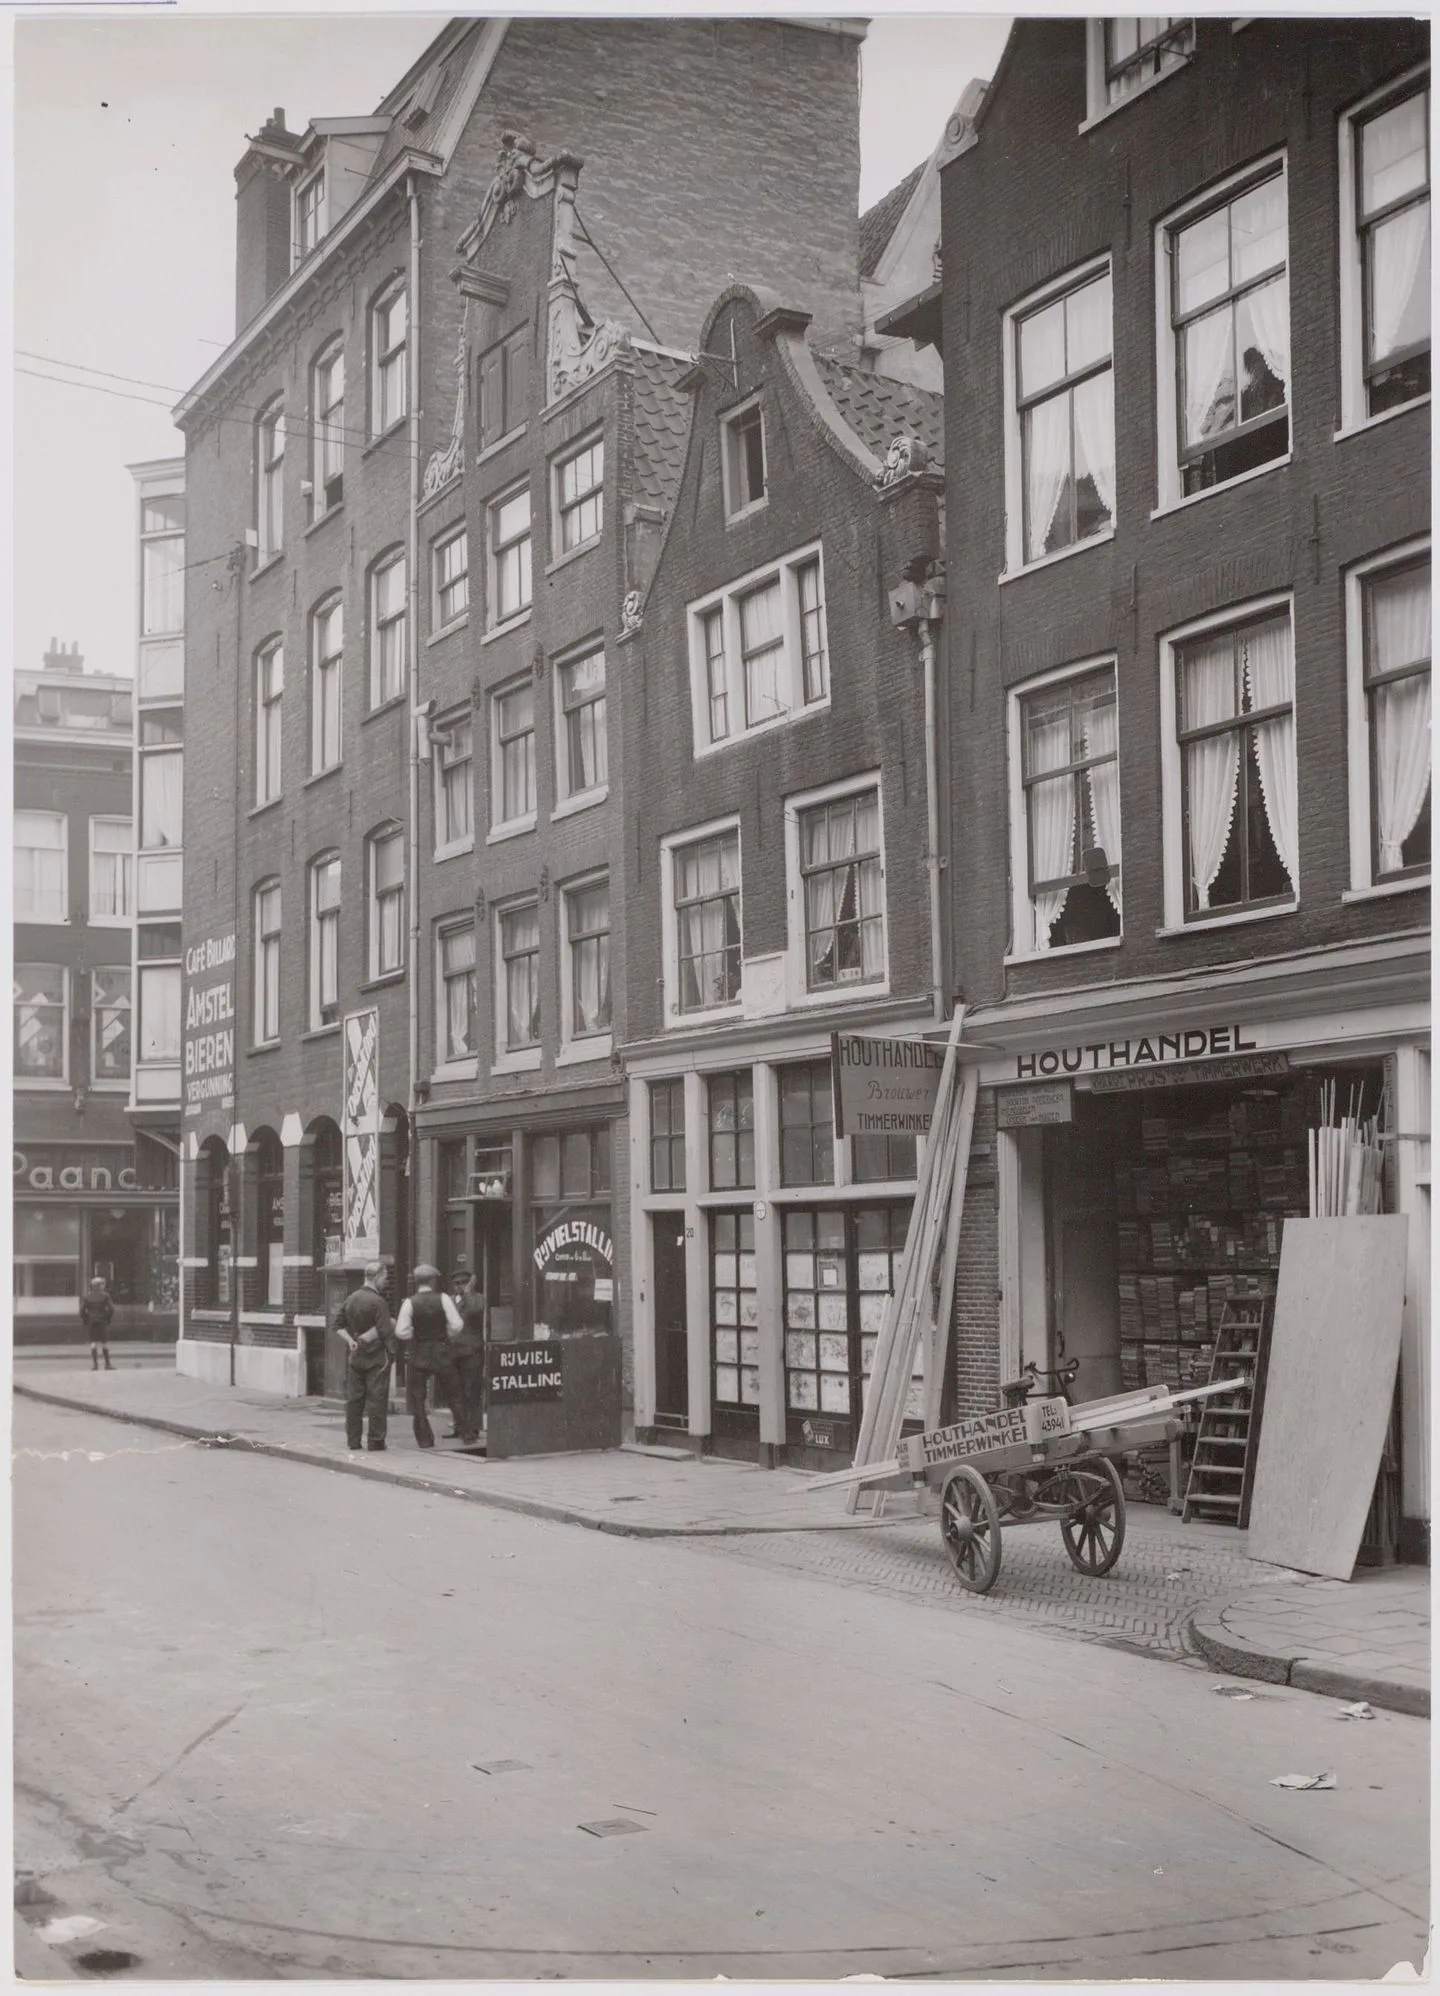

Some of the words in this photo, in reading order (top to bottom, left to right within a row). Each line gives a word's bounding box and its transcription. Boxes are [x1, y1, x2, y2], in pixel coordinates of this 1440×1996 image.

[186, 983, 234, 1030] AMSTEL
[185, 1029, 233, 1075] BIEREN
[1017, 1025, 1256, 1078] HOUTHANDEL
[1190, 1053, 1284, 1081] TIMMERWERK
[867, 1080, 929, 1100] Brouwer
[492, 1372, 562, 1391] STALLING
[922, 1409, 1027, 1448] HOUTHANDEL
